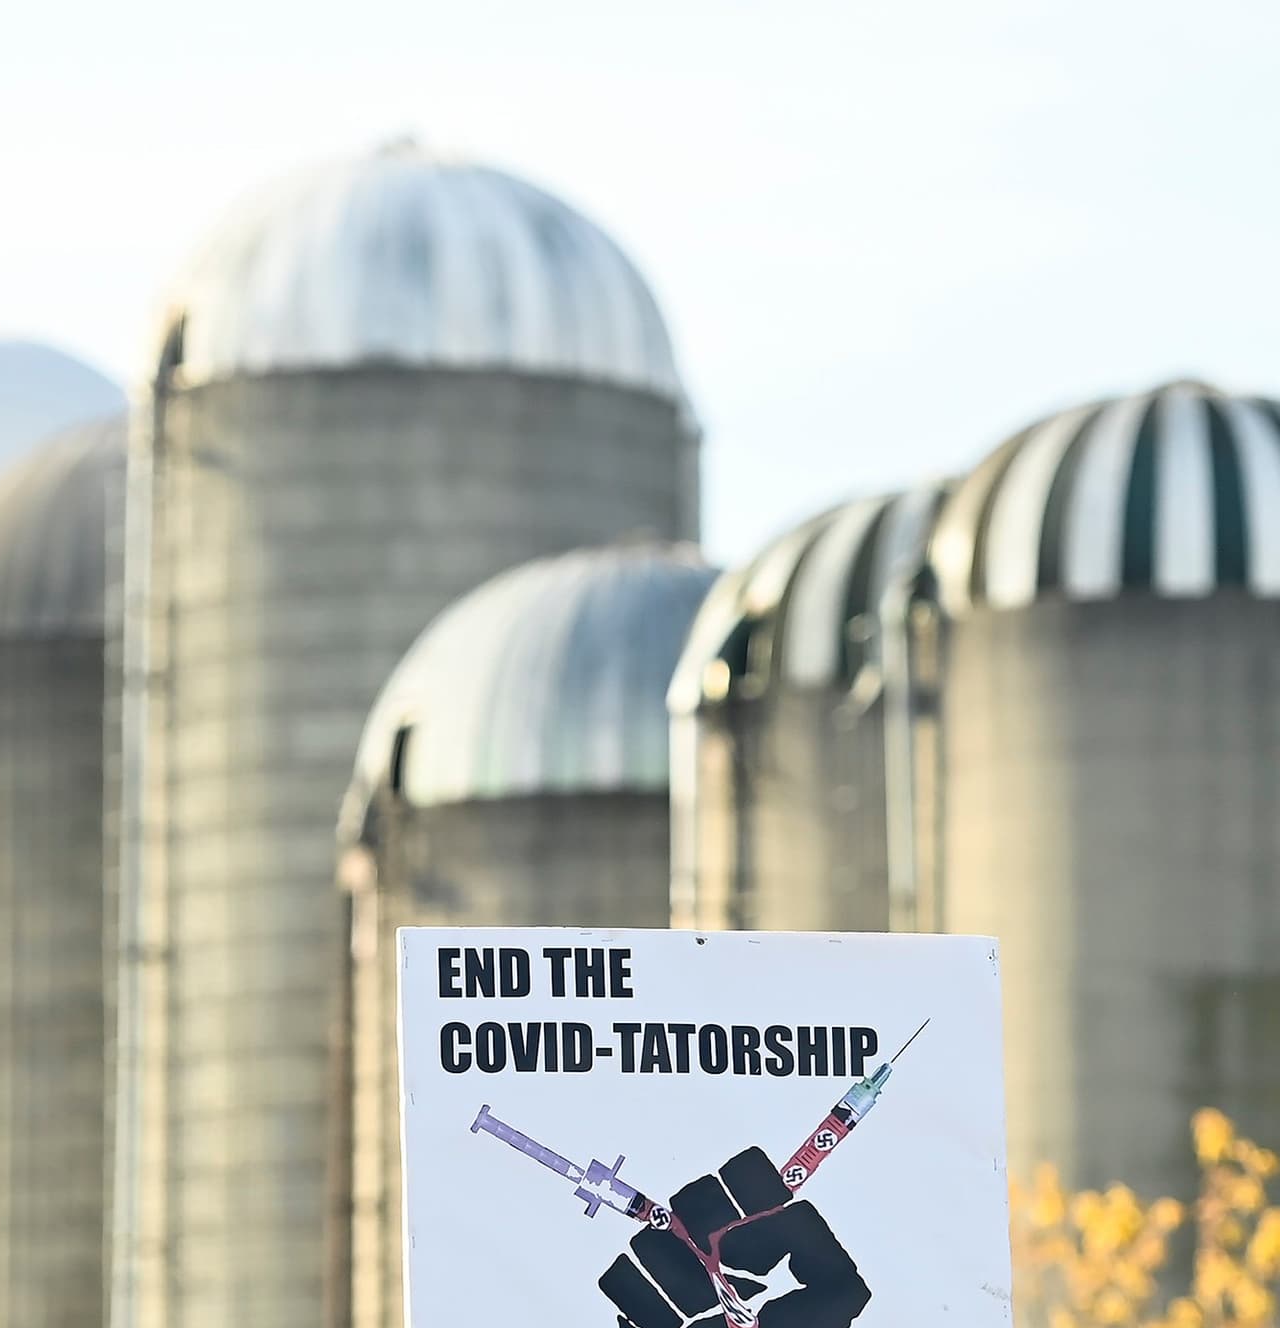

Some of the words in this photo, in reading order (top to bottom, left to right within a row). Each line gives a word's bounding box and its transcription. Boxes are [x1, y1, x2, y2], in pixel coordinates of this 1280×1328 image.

[437, 947, 531, 998] END
[542, 947, 634, 999] THE
[440, 1022, 878, 1077] COVID-TATORSHIP
